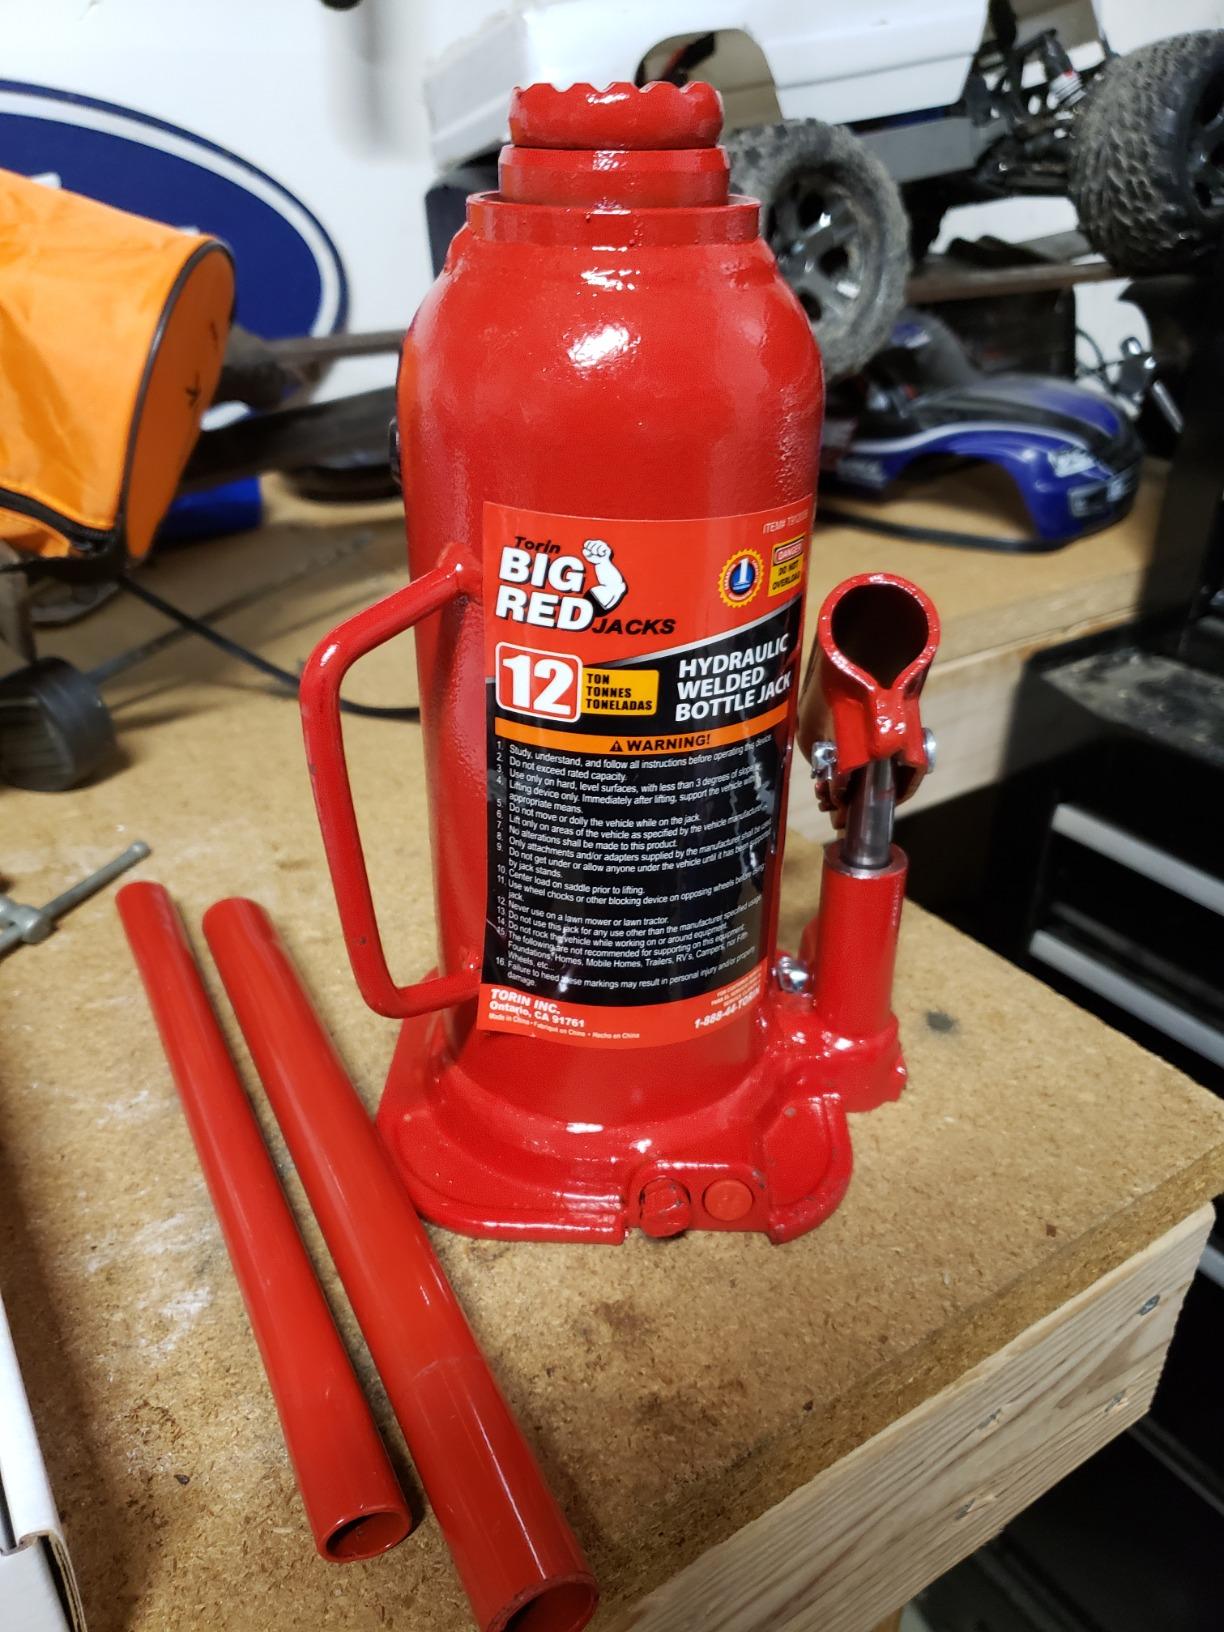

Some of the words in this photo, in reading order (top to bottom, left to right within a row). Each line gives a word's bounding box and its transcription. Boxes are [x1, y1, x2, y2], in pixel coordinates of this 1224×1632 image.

[514, 536, 561, 554] Torin
[499, 547, 585, 593] BIG
[778, 566, 788, 576] DO
[496, 585, 594, 631] RED
[592, 619, 676, 635] JACKS
[679, 633, 789, 678] HYDRAULIC
[502, 655, 574, 716] 12
[587, 673, 609, 684] TON
[677, 666, 764, 699] WELDED
[586, 699, 652, 710] TONELADAS
[587, 686, 631, 698] TONNES
[675, 689, 756, 721] BOTTLE
[757, 671, 791, 704] JACK
[627, 734, 710, 752] WARNING!
[509, 756, 520, 766] Do
[522, 762, 535, 770] not
[536, 766, 566, 776] exceed
[568, 769, 589, 779] rated
[585, 759, 601, 768] and
[603, 760, 628, 769] follow
[642, 758, 687, 768] instructions
[688, 753, 712, 765] before
[509, 780, 532, 794] Lifting
[534, 788, 559, 798] device
[582, 796, 632, 806] Immediately
[633, 796, 652, 804] after
[680, 789, 707, 801] support
[721, 780, 742, 792] vehicle
[510, 768, 524, 779] Use
[526, 774, 542, 785] only
[556, 778, 577, 790] hard,
[580, 782, 599, 791] level
[601, 783, 638, 793] surfaces,
[641, 784, 657, 792] with
[659, 782, 675, 791] less
[677, 780, 694, 789] than
[702, 773, 730, 786] degrees
[509, 793, 552, 809] appropriate
[554, 802, 583, 814] means.
[509, 803, 520, 812] Do
[522, 806, 534, 816] not
[536, 811, 557, 821] move
[569, 816, 588, 827] dolly
[590, 818, 604, 826] the
[606, 819, 634, 828] vehicle
[636, 819, 657, 828] while
[671, 816, 682, 824] the
[509, 814, 520, 824] Lift
[522, 818, 538, 830] only
[551, 826, 574, 835] areas
[586, 829, 598, 837] the
[601, 831, 629, 839] vehicle
[643, 828, 678, 839] specified
[704, 819, 726, 831] vehicle
[509, 837, 525, 849] Only
[528, 842, 574, 858] attachments
[576, 850, 602, 860] and/or
[604, 852, 639, 862] adapters
[642, 852, 673, 861] supplied
[686, 845, 698, 853] the
[521, 829, 560, 844] alterations
[562, 838, 581, 846] shall
[595, 841, 618, 850] made
[631, 841, 645, 849] this
[518, 862, 533, 872] jack
[548, 859, 570, 869] under
[606, 865, 635, 874] anyone
[638, 863, 660, 872] under
[662, 862, 674, 870] the
[676, 858, 701, 868] vehicle
[702, 854, 716, 863] until
[508, 880, 522, 890] Use
[524, 885, 545, 896] wheel
[547, 891, 574, 901] chocks
[586, 896, 606, 904] other
[608, 897, 642, 906] blocking
[643, 896, 668, 904] device
[681, 888, 712, 900] opposing
[509, 869, 532, 882] Center
[535, 876, 550, 886] load
[564, 883, 590, 892] saddle
[592, 886, 610, 894] prior
[508, 901, 529, 912] Never
[531, 908, 544, 916] use
[565, 914, 582, 923] lawn
[585, 918, 611, 926] mower
[623, 918, 642, 926] lawn
[533, 929, 548, 939] rock
[563, 936, 591, 945] vehicle
[593, 939, 613, 947] while
[615, 940, 644, 948] working
[668, 932, 692, 943] around
[548, 922, 561, 930] this
[593, 929, 608, 938] any
[626, 928, 646, 936] other
[666, 926, 678, 934] the
[509, 931, 521, 941] The
[523, 936, 555, 951] following
[570, 946, 583, 954] not
[584, 948, 639, 958] recommended
[654, 942, 691, 956] supporting
[702, 938, 714, 946] this
[508, 961, 531, 974] Failure
[541, 972, 559, 981] heed
[584, 980, 618, 989] markings
[620, 981, 637, 990] may
[669, 971, 699, 985] personal
[586, 959, 612, 967] Mobile
[489, 1001, 531, 1018] Ontario,
[535, 1011, 549, 1021] CA
[552, 1015, 584, 1027] 91761
[491, 989, 530, 1006] TORIN
[534, 1000, 560, 1014] INC.
